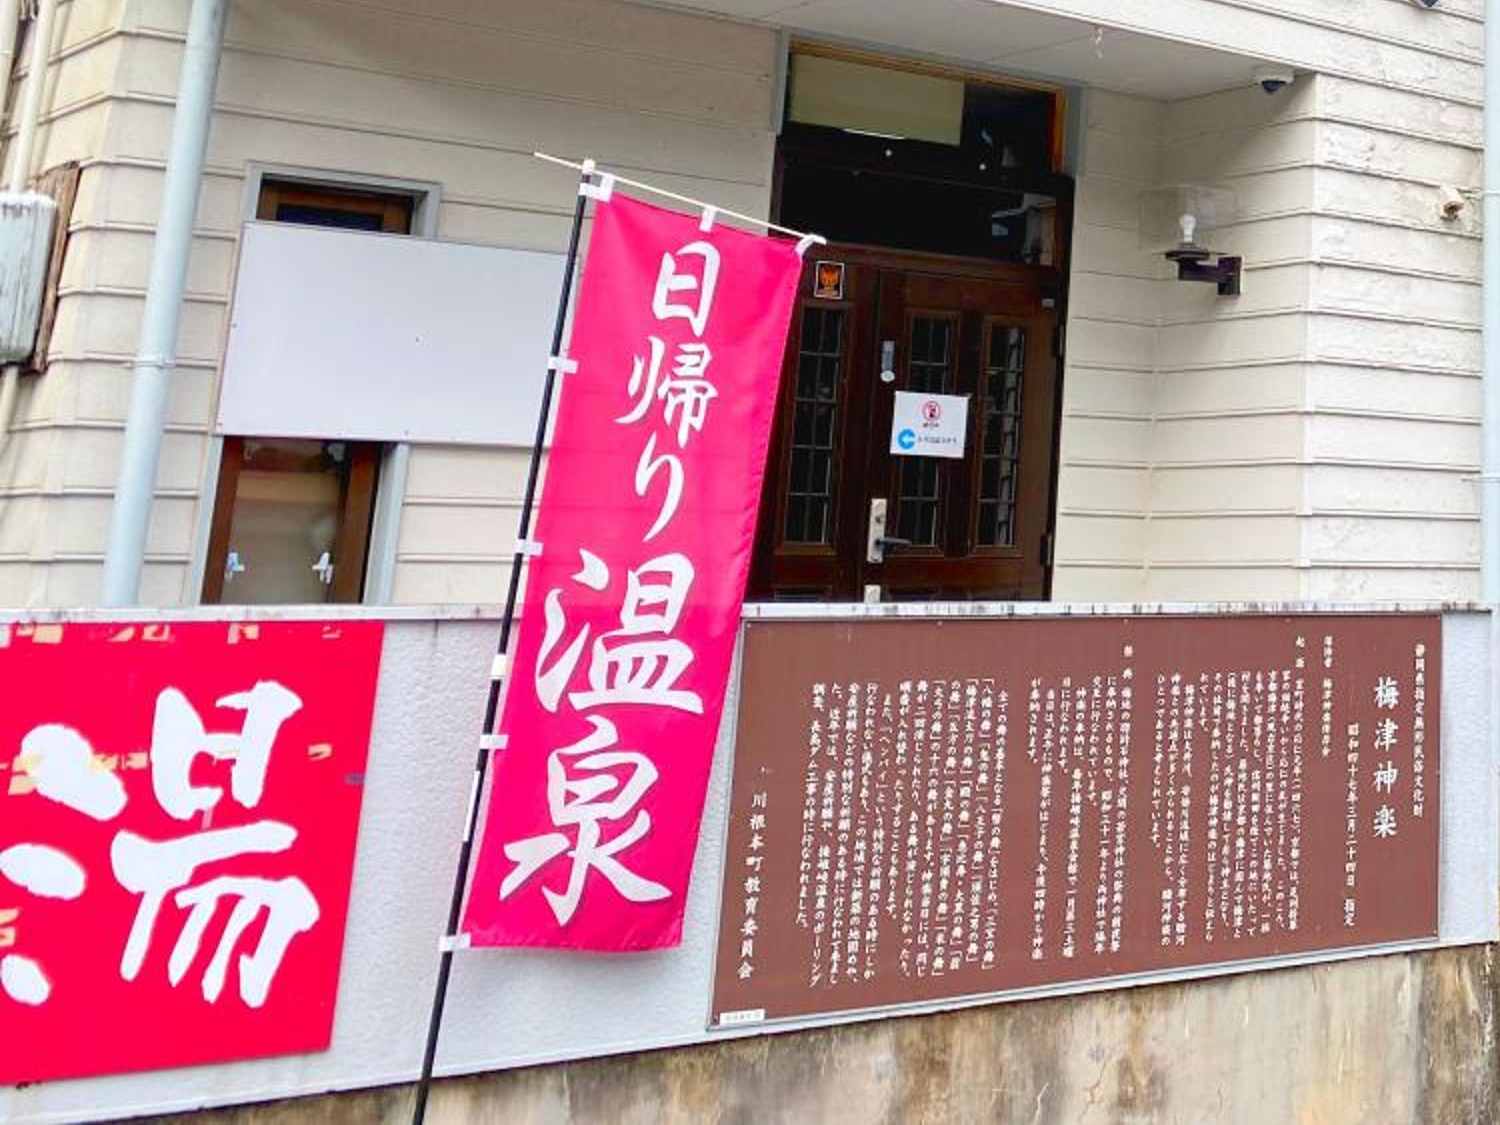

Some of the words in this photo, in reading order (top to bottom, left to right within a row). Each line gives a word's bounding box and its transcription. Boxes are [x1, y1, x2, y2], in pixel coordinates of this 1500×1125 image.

[499, 239, 719, 926] 日帰り温泉
[1373, 677, 1399, 838] 梅津神楽
